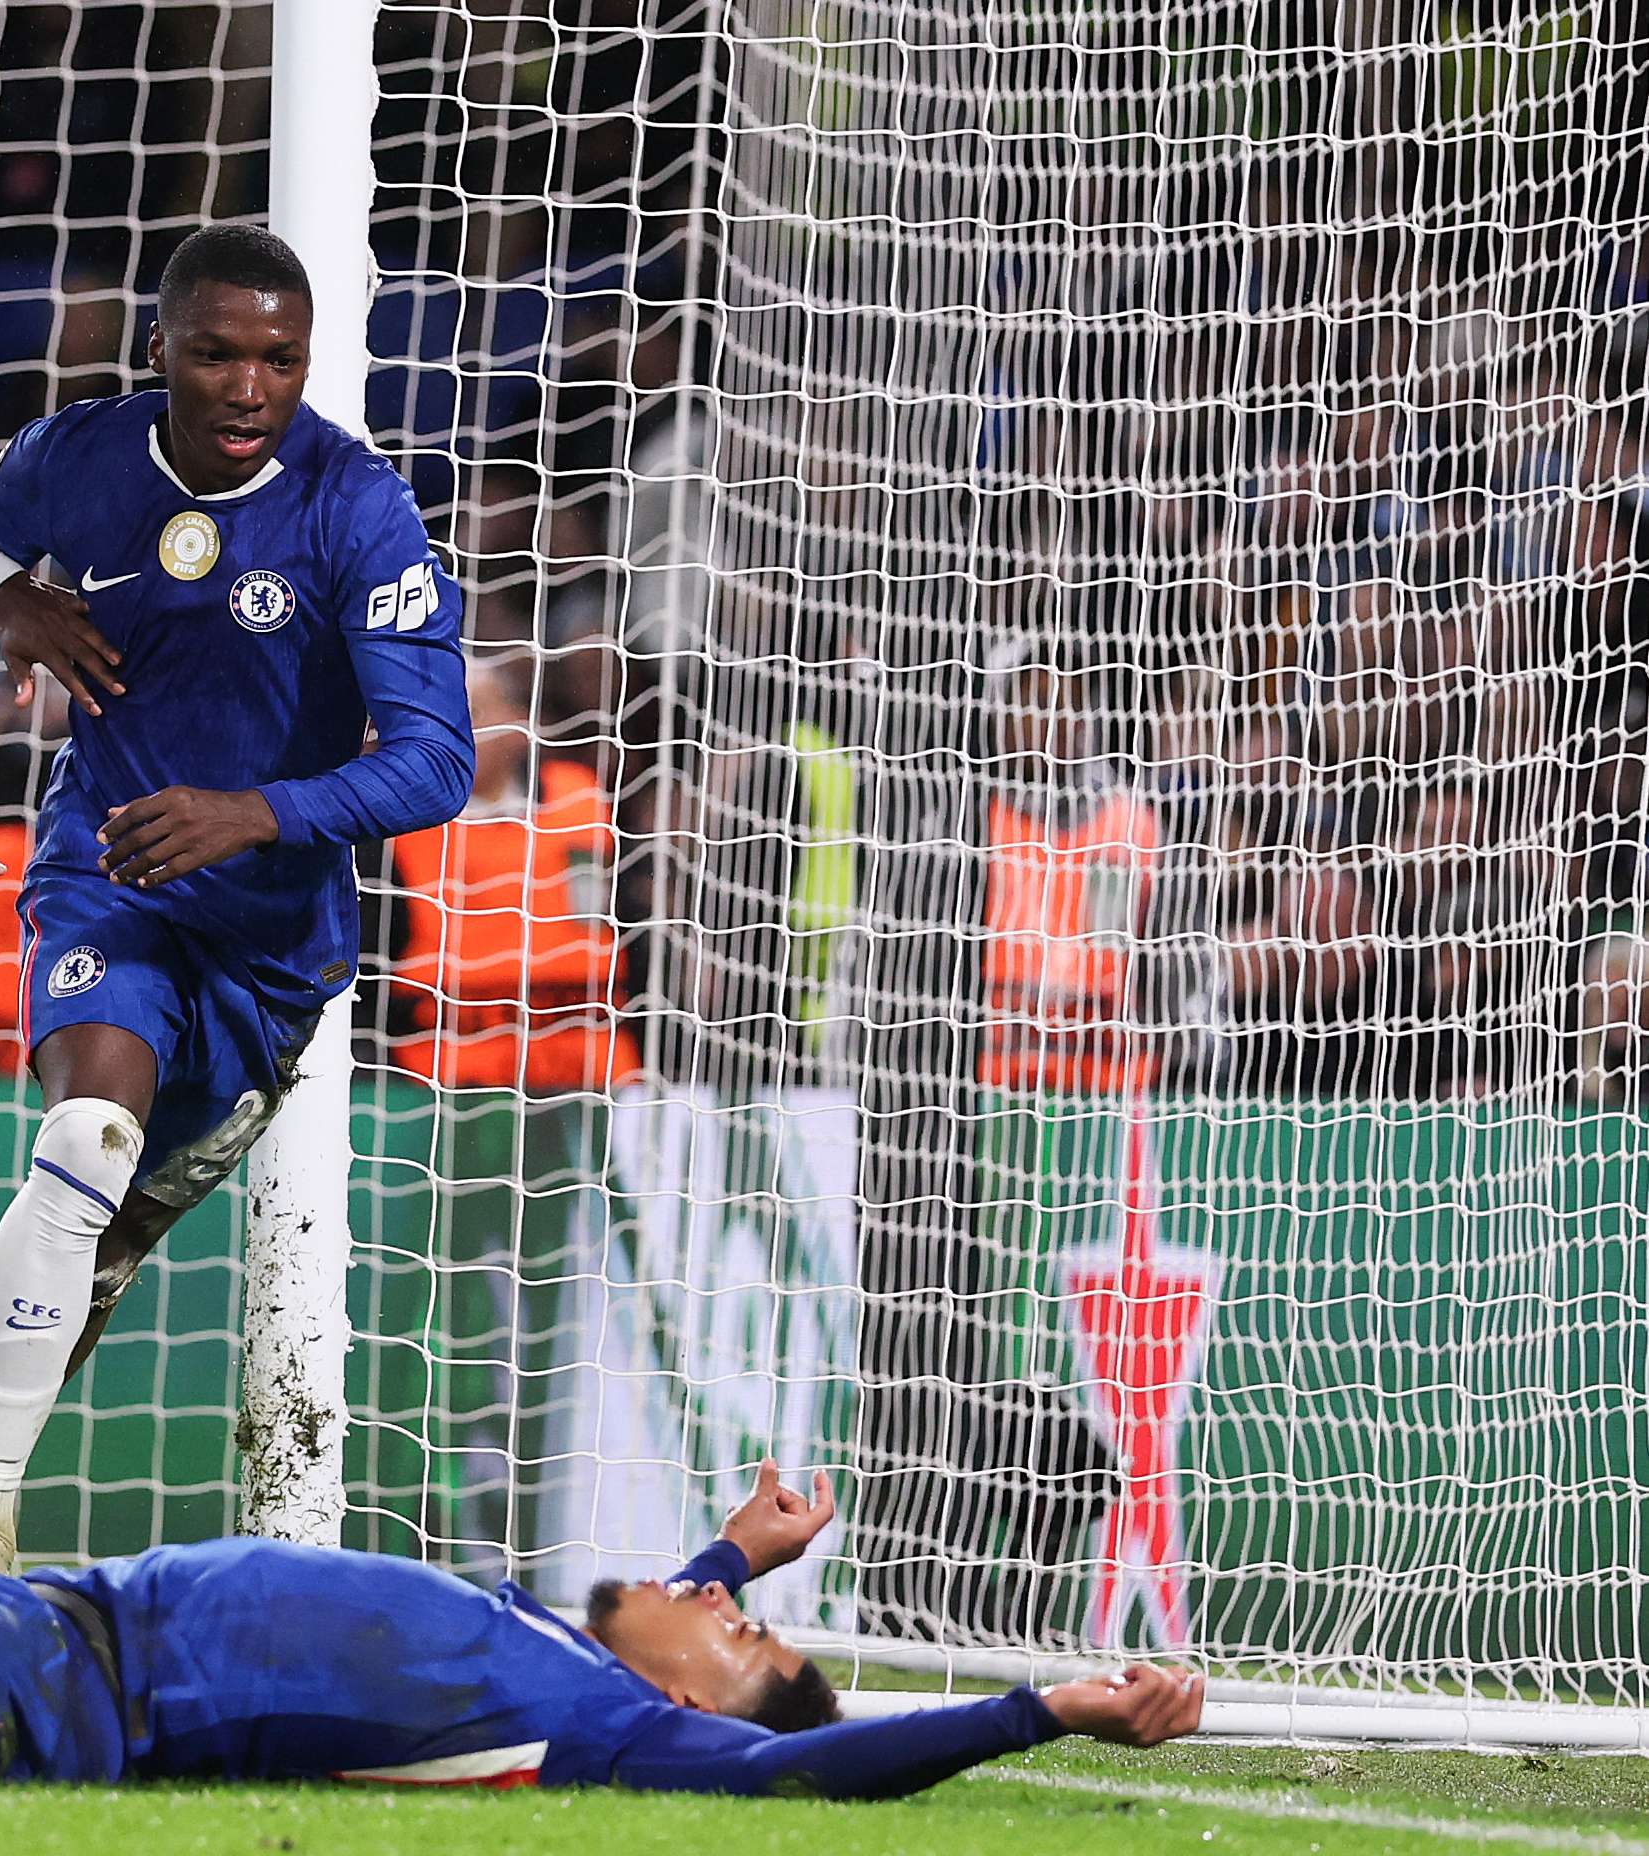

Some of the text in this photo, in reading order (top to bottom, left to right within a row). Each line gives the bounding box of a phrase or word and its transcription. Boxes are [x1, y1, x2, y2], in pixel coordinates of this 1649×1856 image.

[165, 517, 216, 557] WORLD CHAMPIONS
[173, 562, 197, 575] FIFA
[242, 572, 283, 588] CHELSEA
[12, 1298, 62, 1320] CFC
